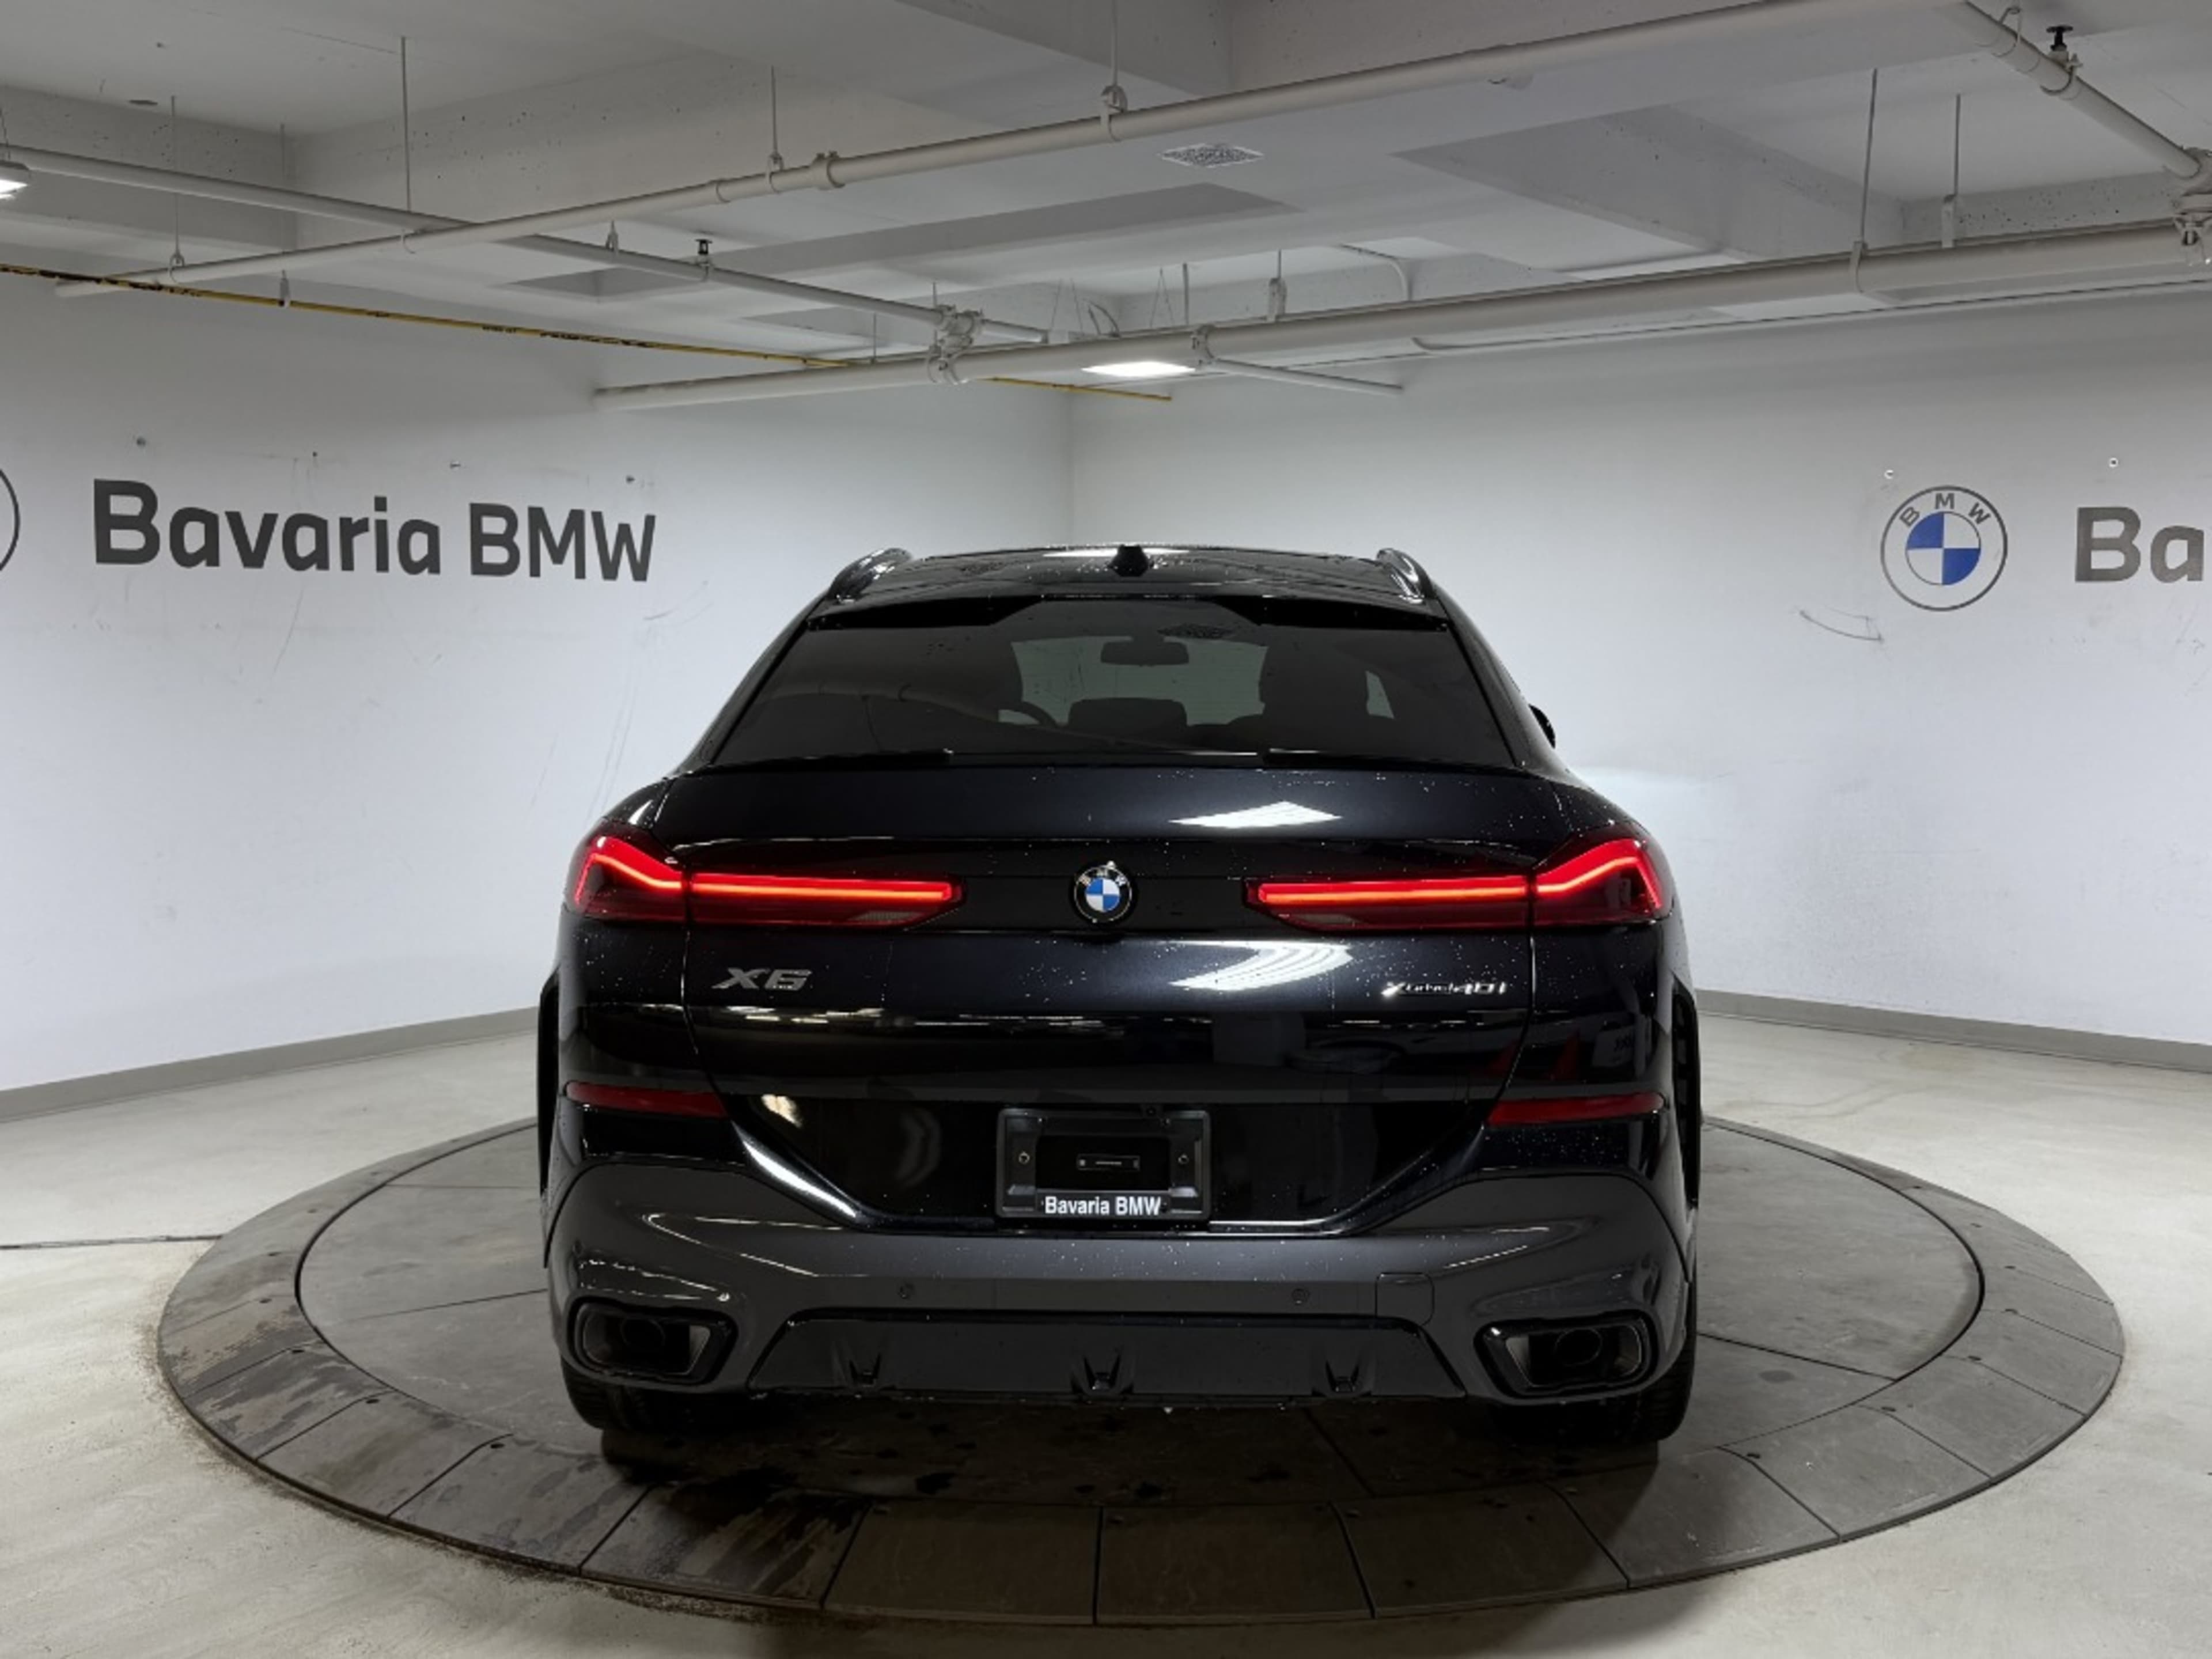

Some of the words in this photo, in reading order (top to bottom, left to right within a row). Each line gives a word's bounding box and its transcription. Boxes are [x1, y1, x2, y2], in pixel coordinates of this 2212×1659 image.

[1900, 493, 1991, 528] BMW
[94, 479, 441, 575] Bavaria
[469, 502, 656, 581] BMW
[712, 967, 812, 990] X6
[1045, 1196, 1109, 1215] Bavaria
[1115, 1196, 1161, 1215] BMW
